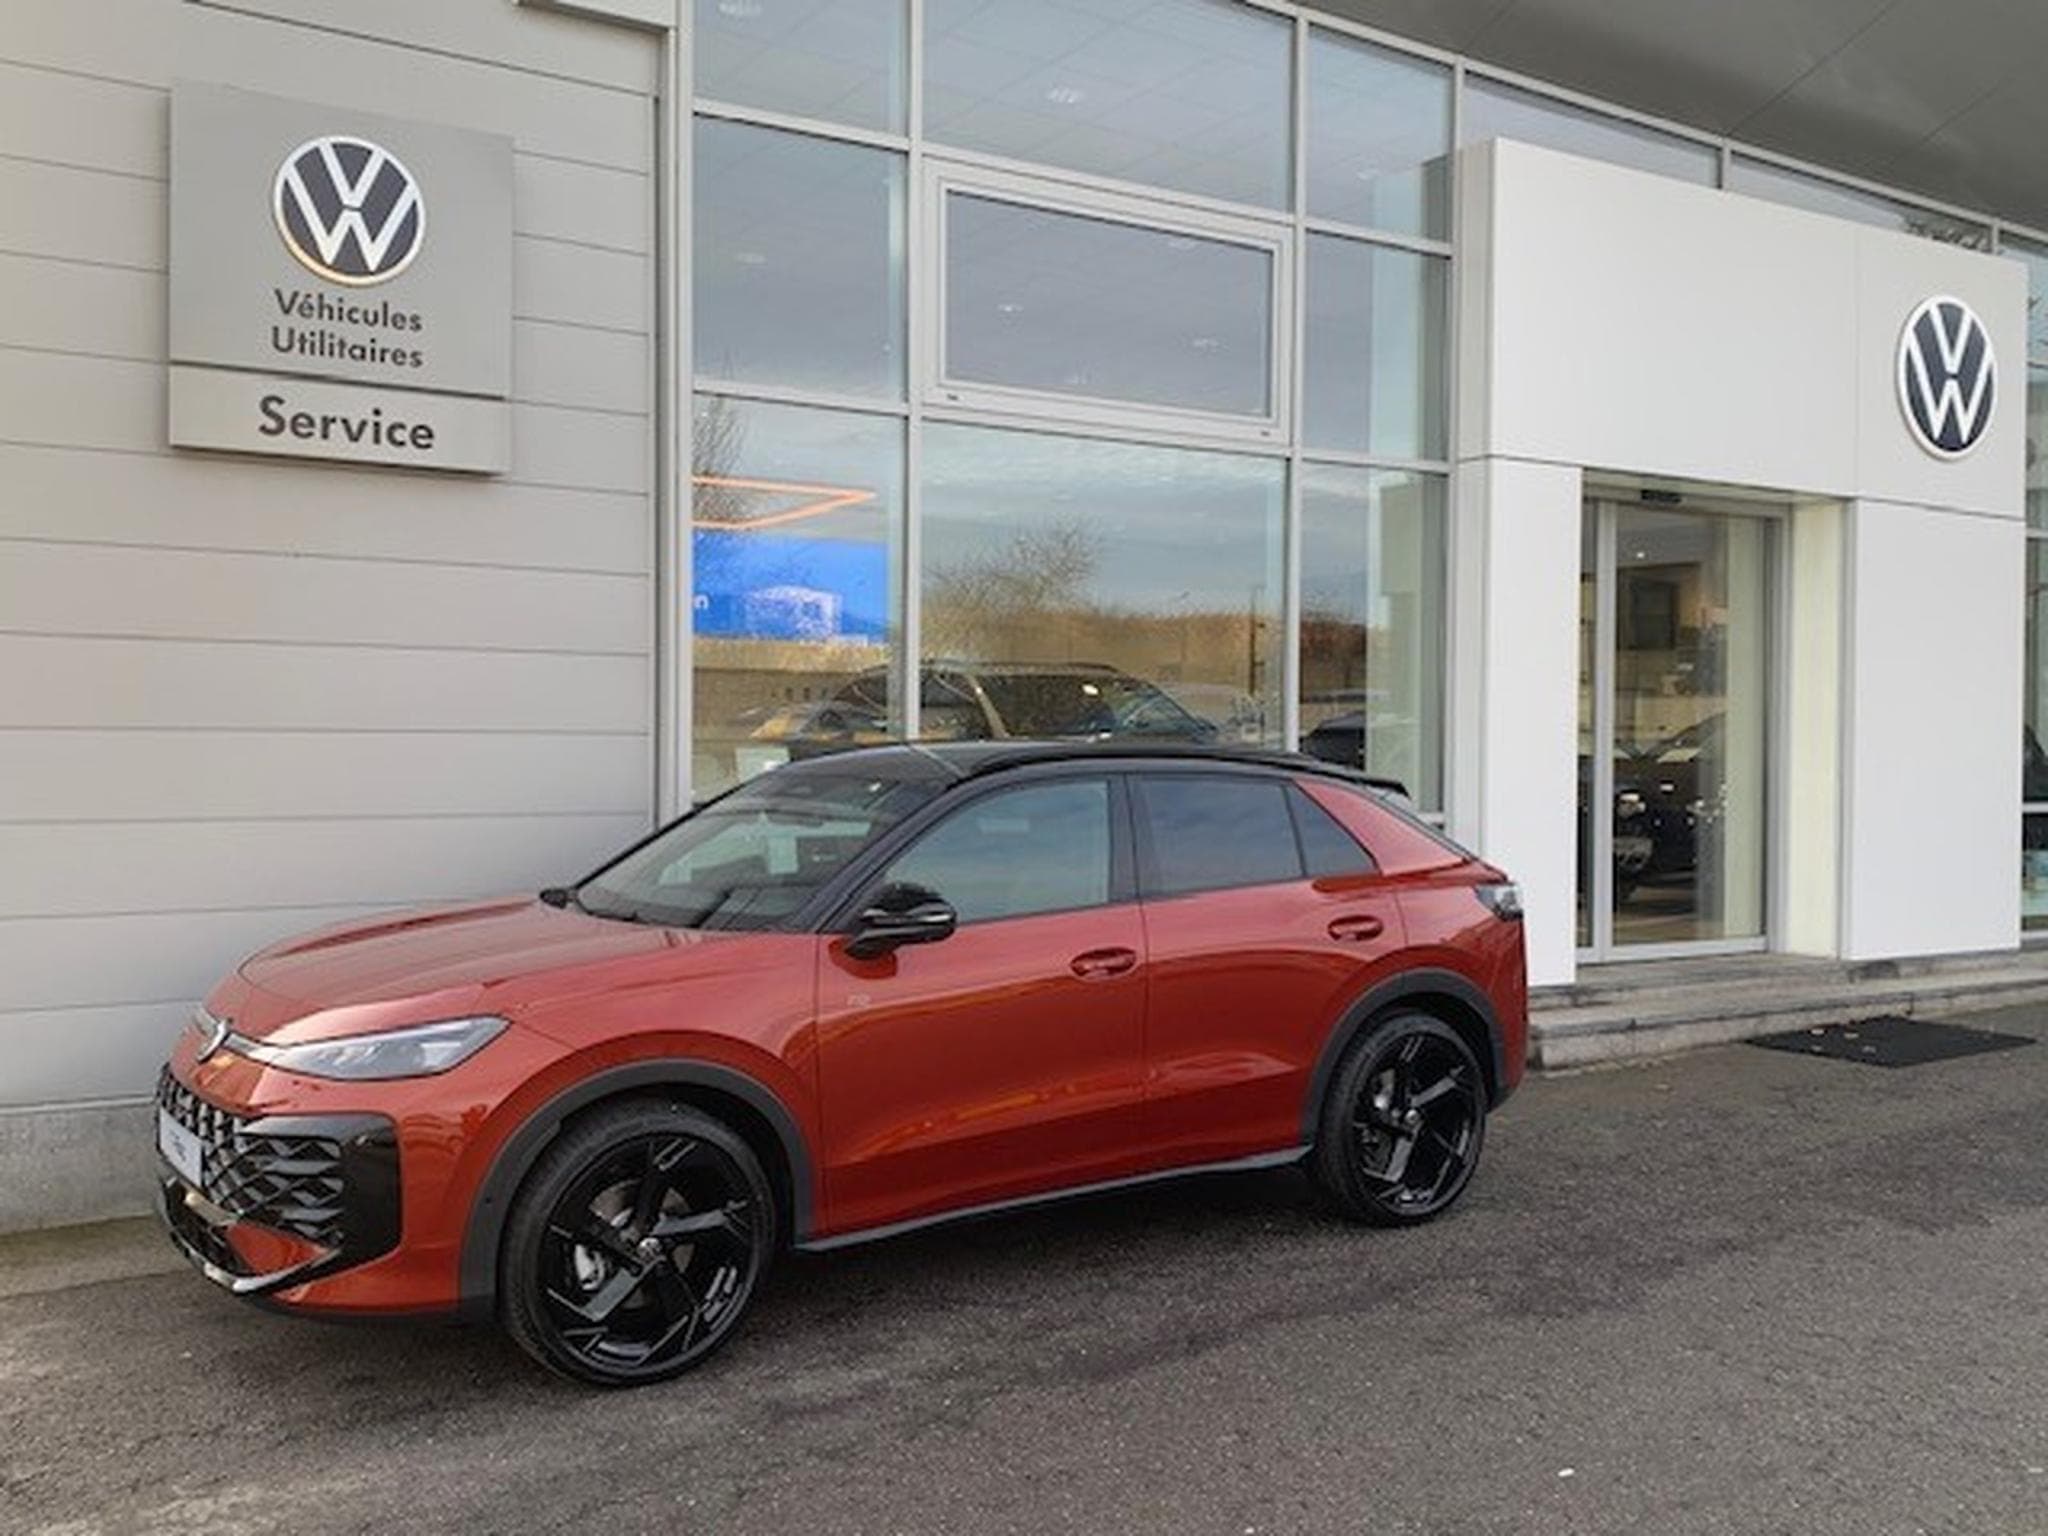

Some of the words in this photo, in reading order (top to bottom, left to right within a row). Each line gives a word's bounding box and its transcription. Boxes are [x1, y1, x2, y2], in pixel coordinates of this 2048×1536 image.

[274, 288, 423, 332] Véhicules
[271, 325, 424, 368] Utilitaires
[257, 394, 435, 450] Service
